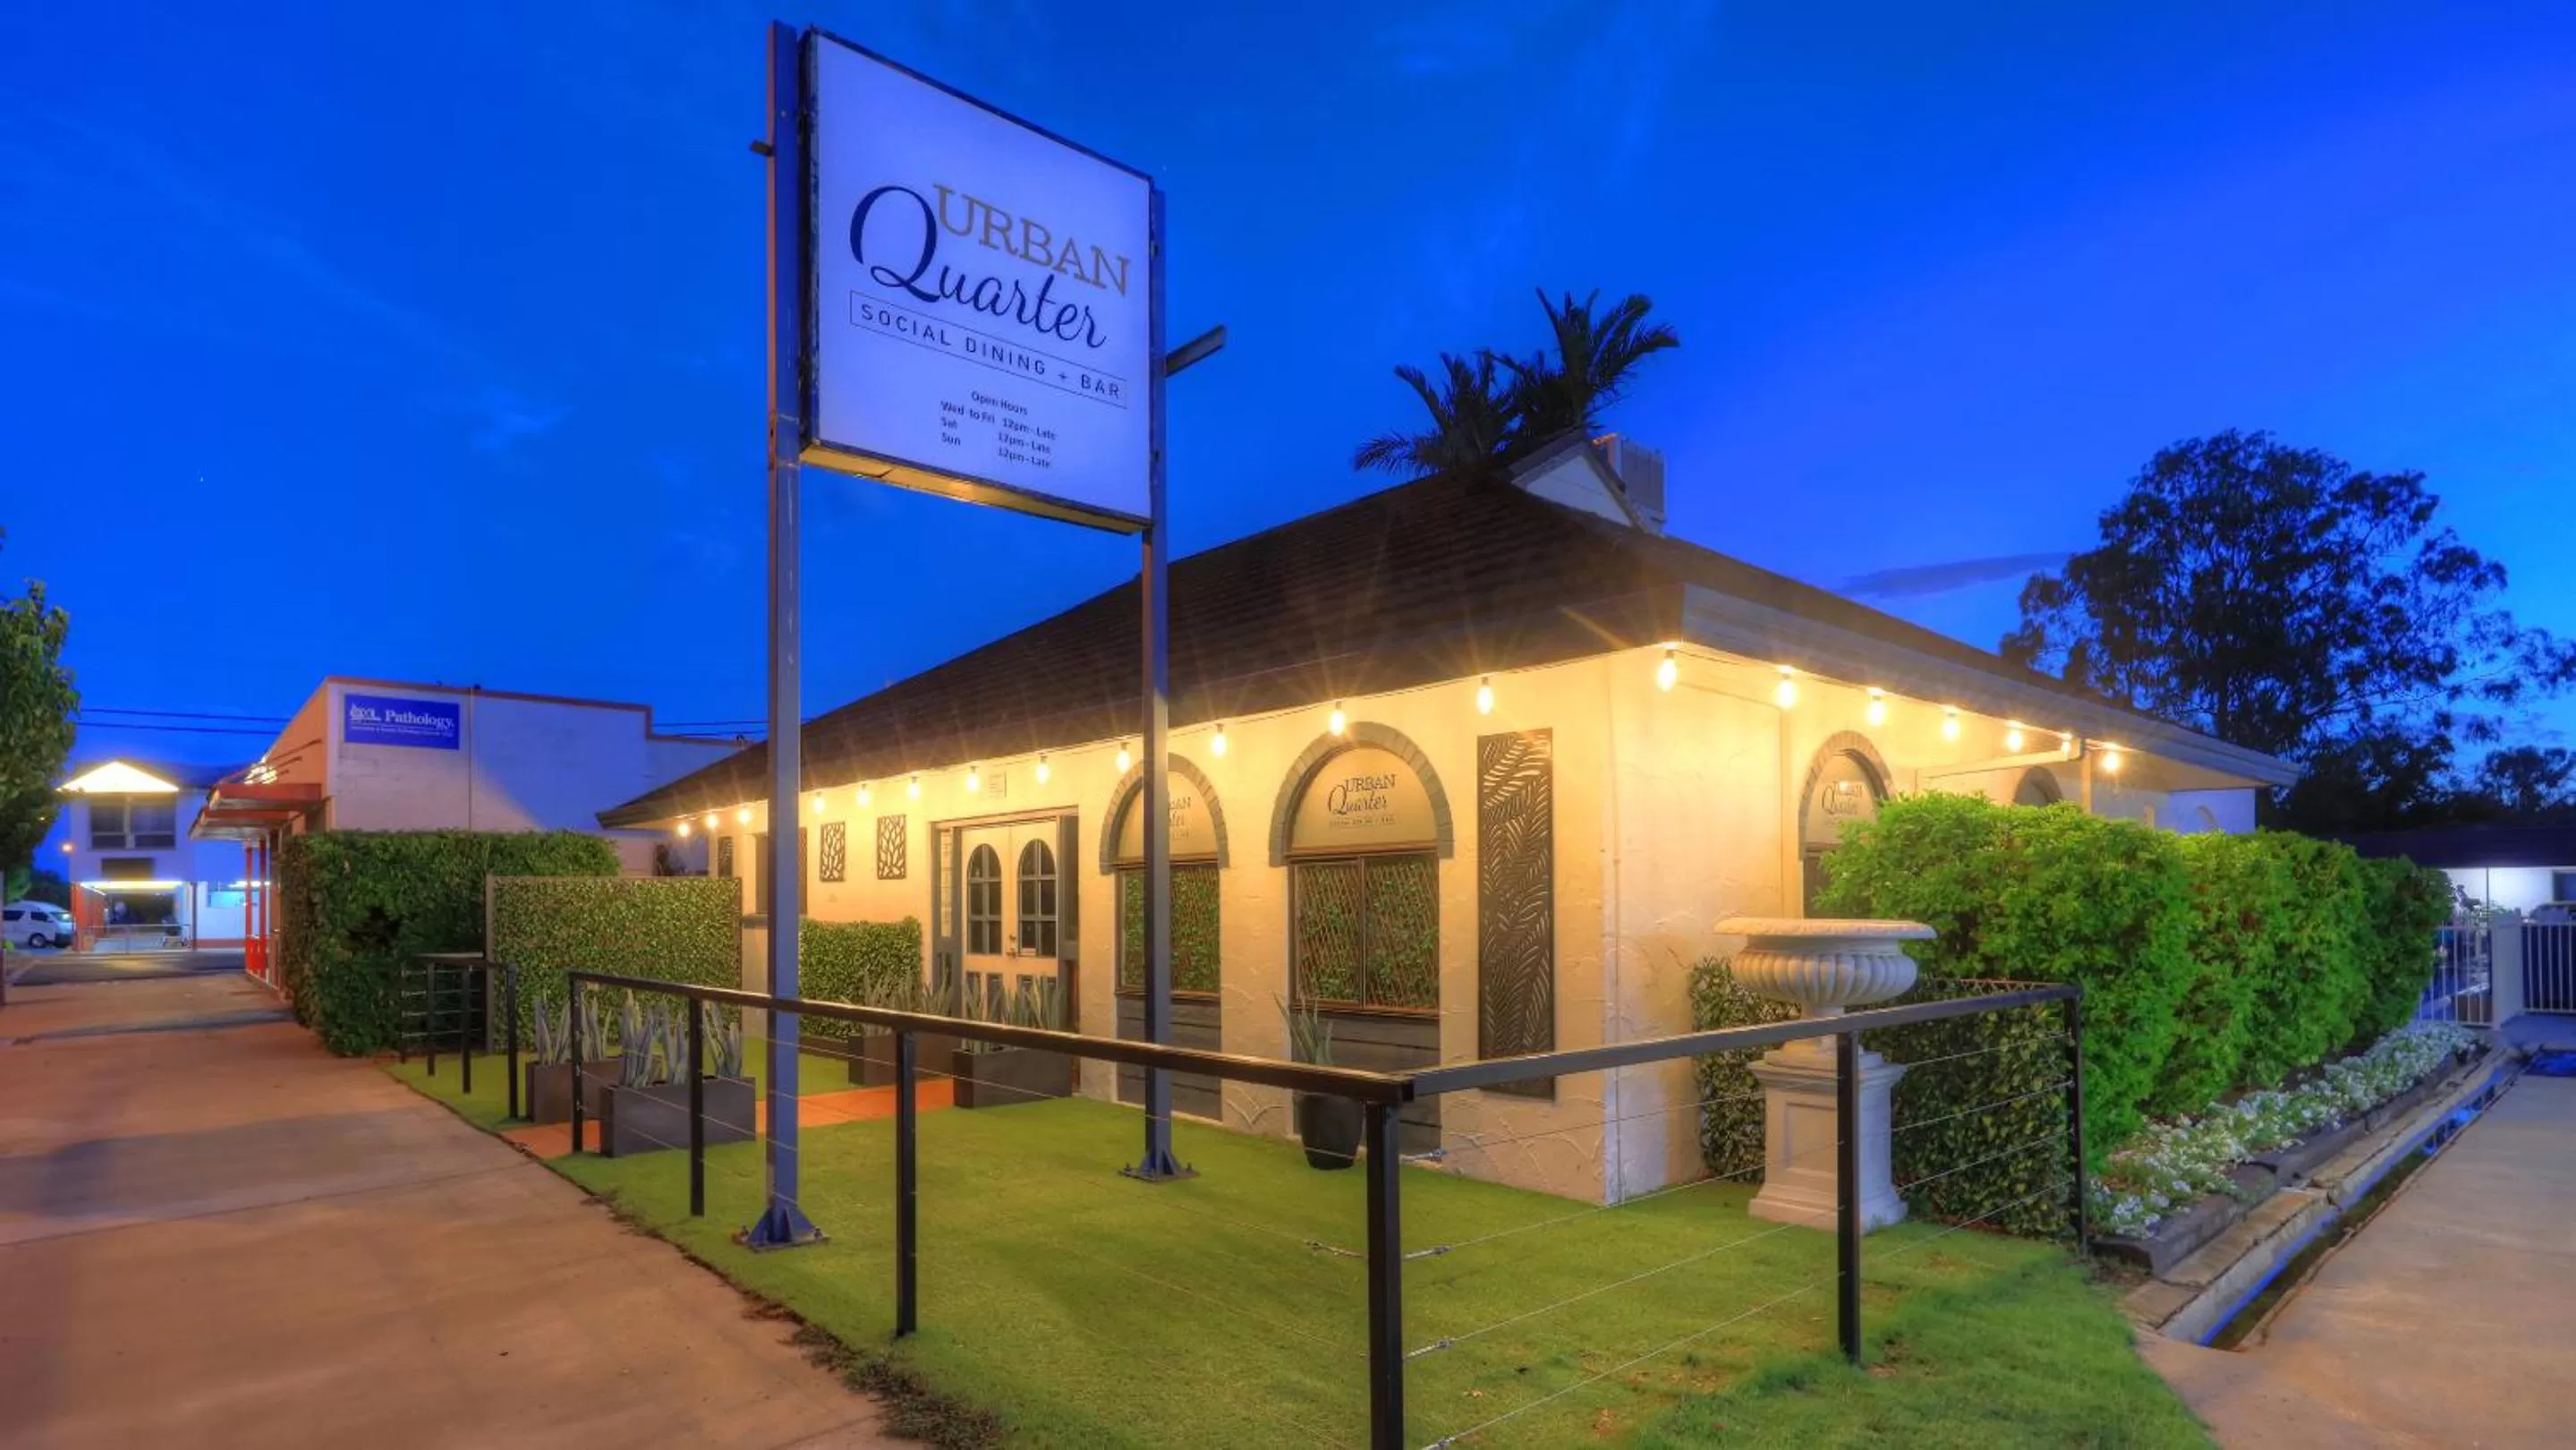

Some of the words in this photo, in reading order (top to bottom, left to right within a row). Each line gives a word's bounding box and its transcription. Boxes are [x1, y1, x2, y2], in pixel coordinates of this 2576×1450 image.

[932, 183, 1131, 296] URBAN
[849, 185, 1108, 349] Quarter
[861, 303, 951, 346] SOCIAL
[965, 336, 1046, 375] DINING
[1081, 372, 1119, 398] BAR
[940, 401, 965, 415] Wed
[969, 408, 981, 420] to
[971, 391, 999, 405] Open
[1000, 399, 1028, 415] Hours
[941, 432, 962, 446] Sun
[1344, 773, 1398, 792] URBAN
